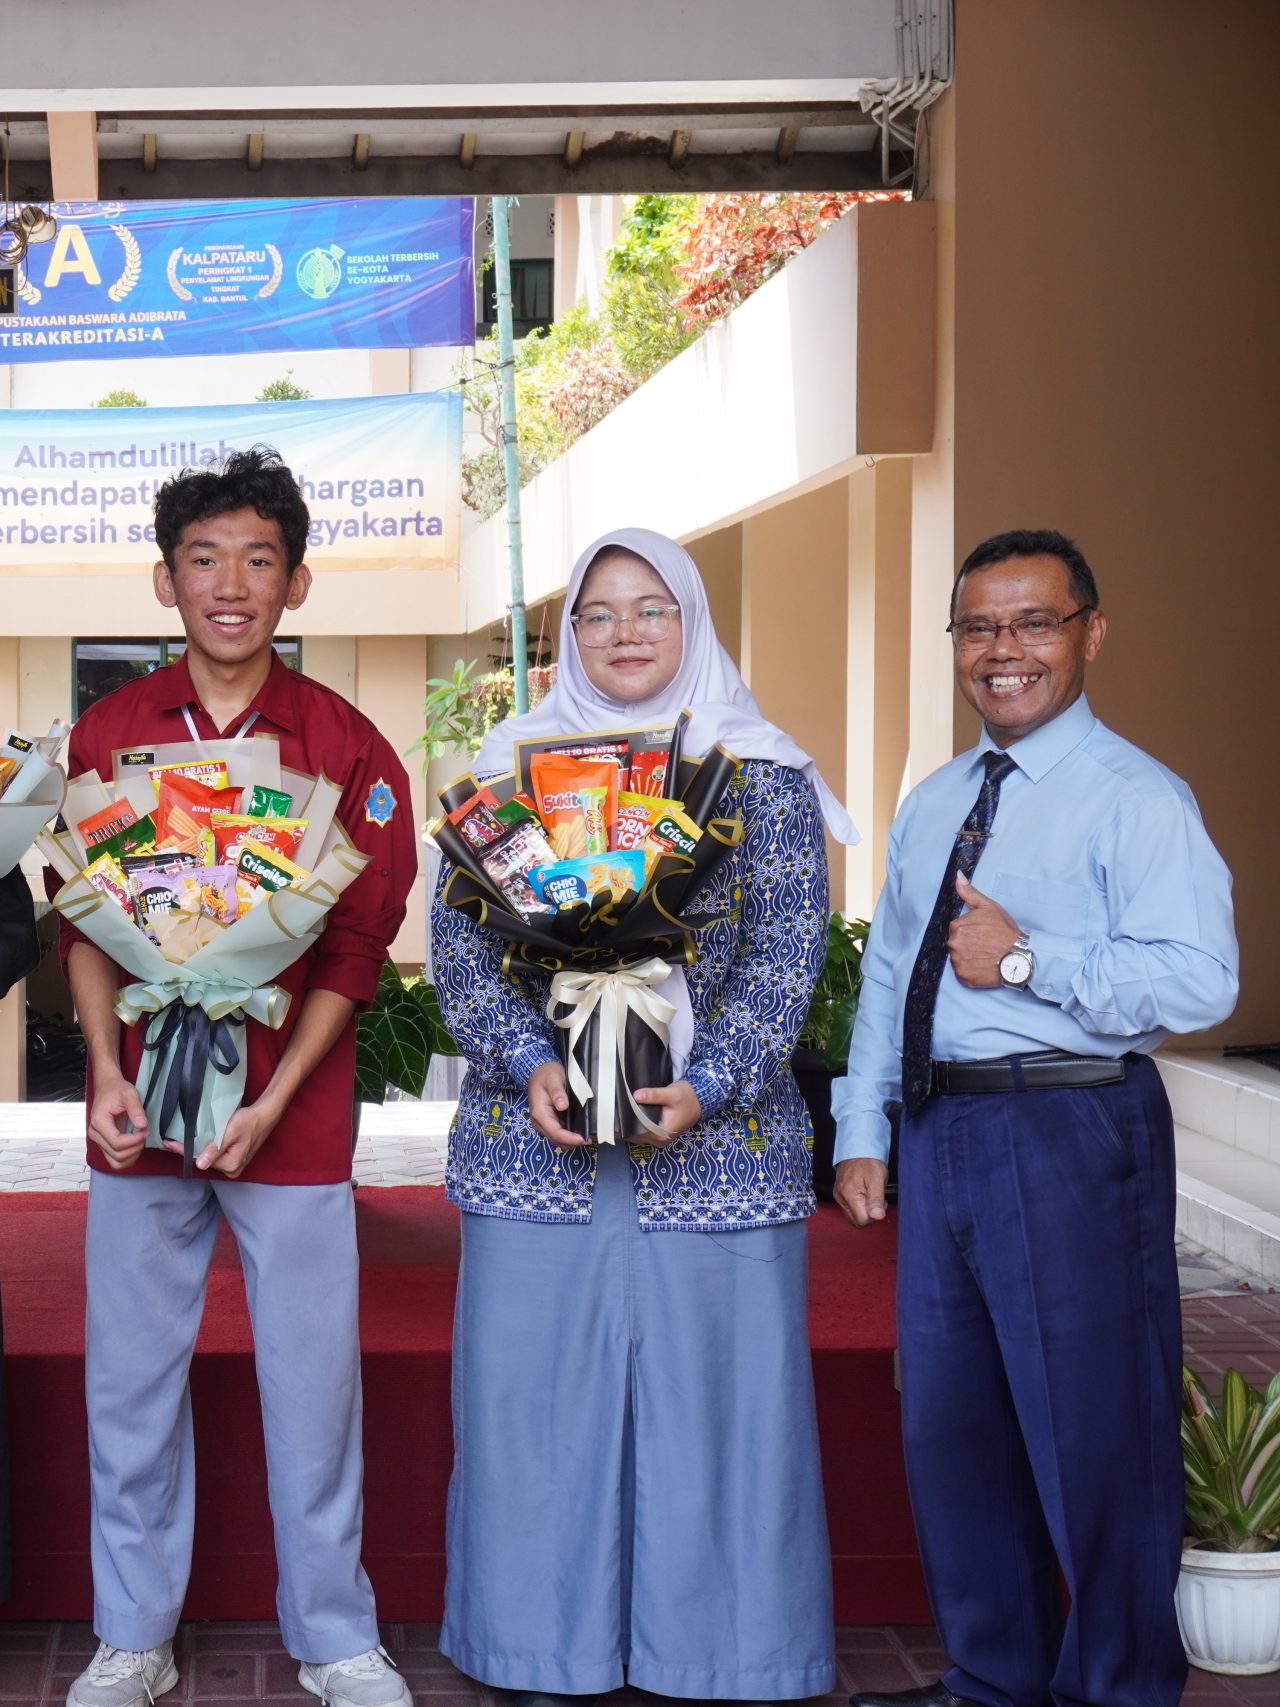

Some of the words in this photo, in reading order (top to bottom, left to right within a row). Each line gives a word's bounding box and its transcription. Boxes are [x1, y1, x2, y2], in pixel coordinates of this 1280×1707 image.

[43, 224, 102, 288] A
[183, 251, 266, 266] KALPATARU
[346, 254, 389, 264] SEKOLAH
[390, 252, 440, 262] TERBERSIH
[198, 266, 245, 276] PERINGKAT
[247, 266, 252, 274] 1
[346, 264, 389, 275] SE-KOTA
[181, 276, 225, 284] PENYELAMAT
[226, 274, 270, 283] LINGKUNGAN
[346, 274, 412, 285] YOGYAKARTA
[210, 285, 240, 293] TINGKAT
[69, 312, 127, 326] BASWARA
[128, 310, 187, 322] ADIBRATA
[0, 326, 165, 347] TERAKREDITASI-A
[14, 440, 236, 469] Alhamdulillah
[297, 474, 425, 508] hargaan
[306, 510, 443, 546] gyakarta
[184, 764, 216, 776] GRATIS
[618, 817, 651, 837] ORN
[550, 876, 578, 892] CHIO
[146, 891, 172, 905] CHIO
[552, 886, 580, 904] MIE
